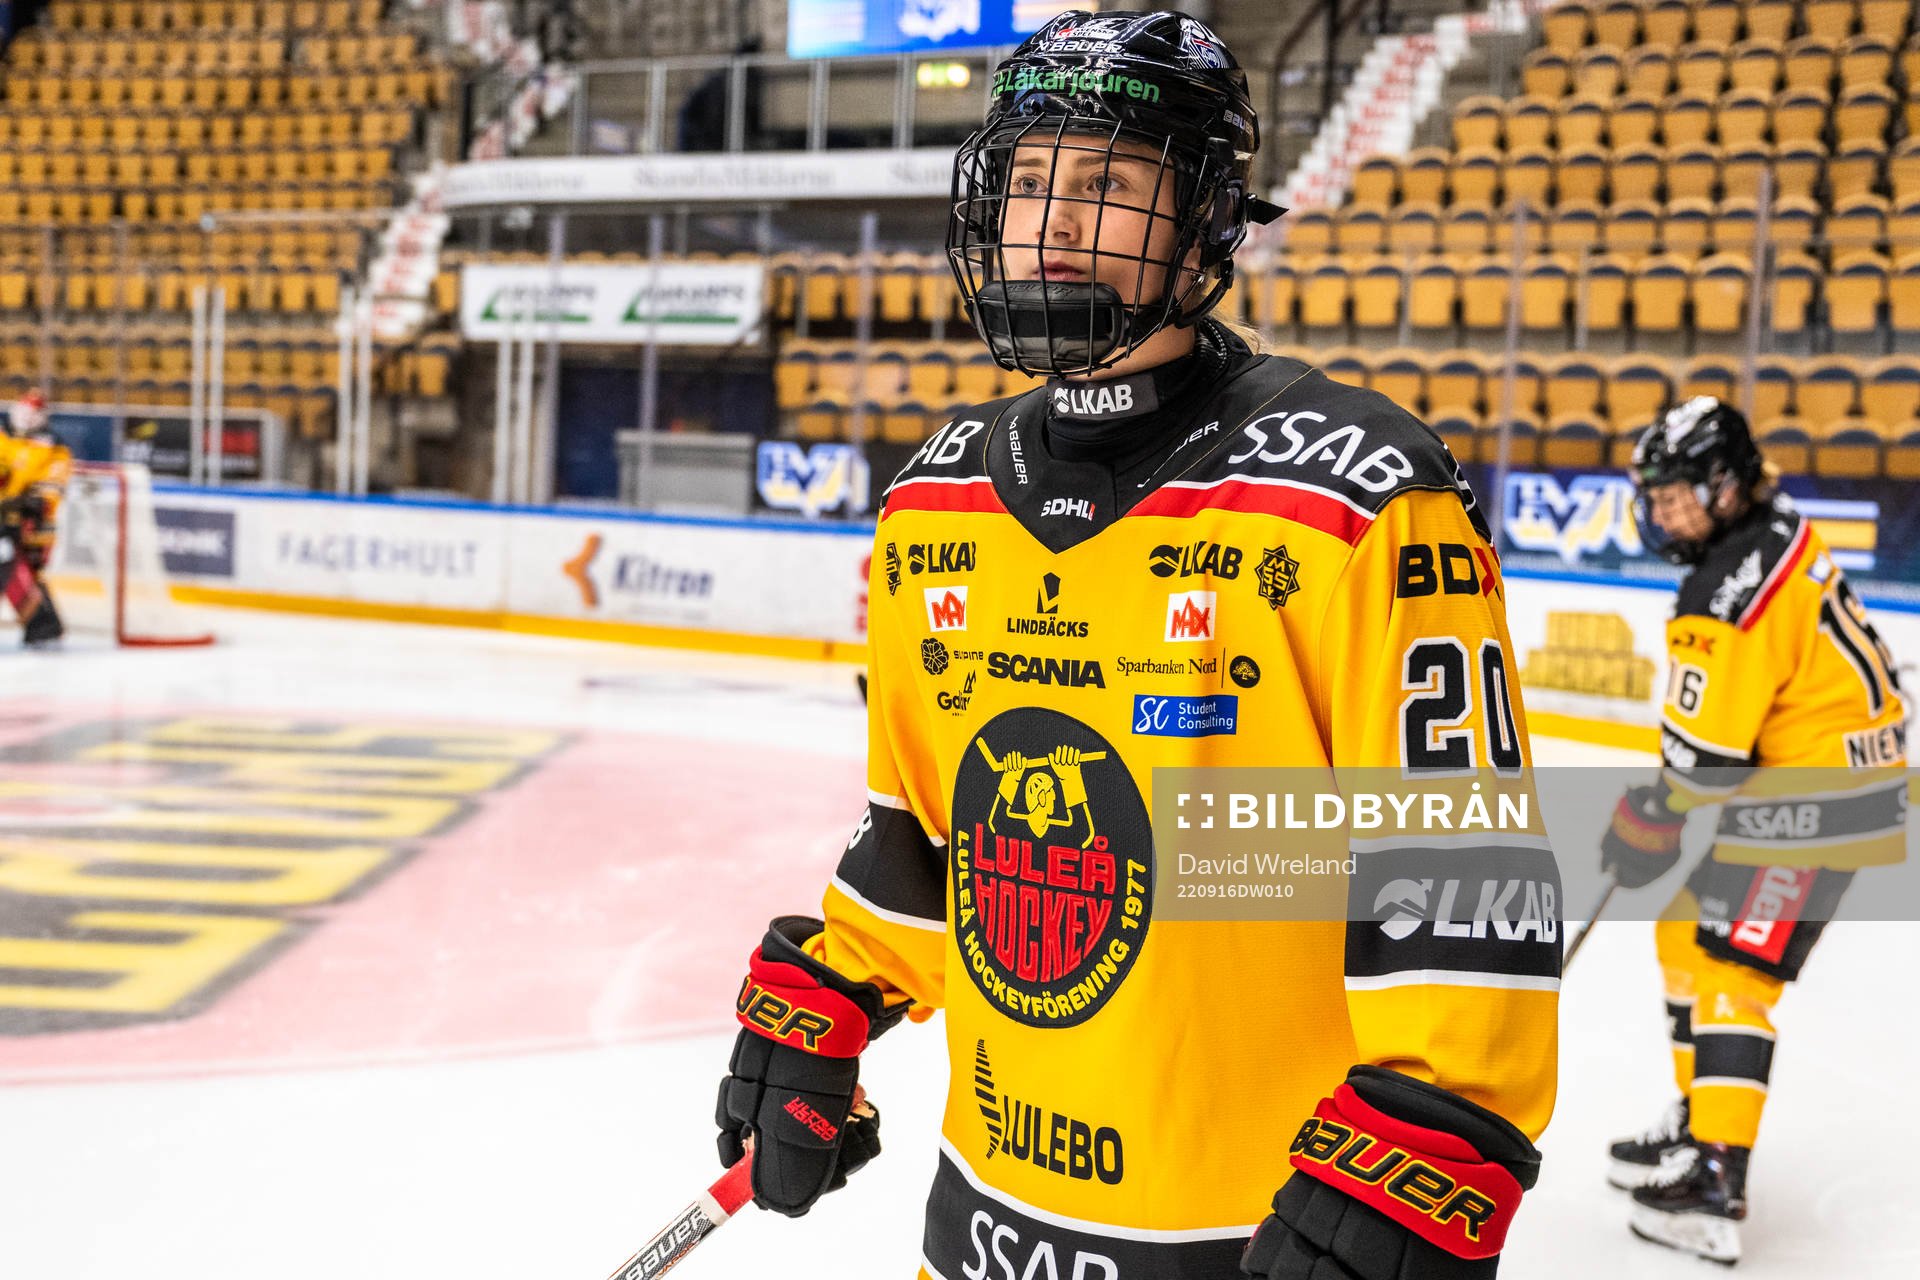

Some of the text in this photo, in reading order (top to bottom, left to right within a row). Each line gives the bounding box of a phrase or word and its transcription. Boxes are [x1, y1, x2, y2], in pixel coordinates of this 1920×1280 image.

[1070, 383, 1134, 415] LKAB
[1228, 410, 1414, 493] SSAB
[277, 530, 479, 578] FAGERHULT
[612, 553, 715, 601] Kitron
[1179, 541, 1243, 580] LKAB
[1006, 617, 1089, 638] LINDBÄCKS
[1170, 596, 1211, 638] MAX
[987, 651, 1106, 689] SCANIA
[1116, 656, 1185, 676] Sparbanken
[1177, 715, 1234, 730] Consulting
[1178, 701, 1217, 715] Student
[1399, 635, 1523, 780] 20
[1735, 803, 1821, 839] SSAB
[973, 822, 1117, 895] LULEÅ
[956, 829, 1148, 1020] LULEÅ HOCKEYFÖRENING 1977
[973, 873, 1113, 984] HOCKEY
[1432, 878, 1557, 944] LKAB
[736, 974, 834, 1052] UER
[1001, 1094, 1124, 1186] LULEBO
